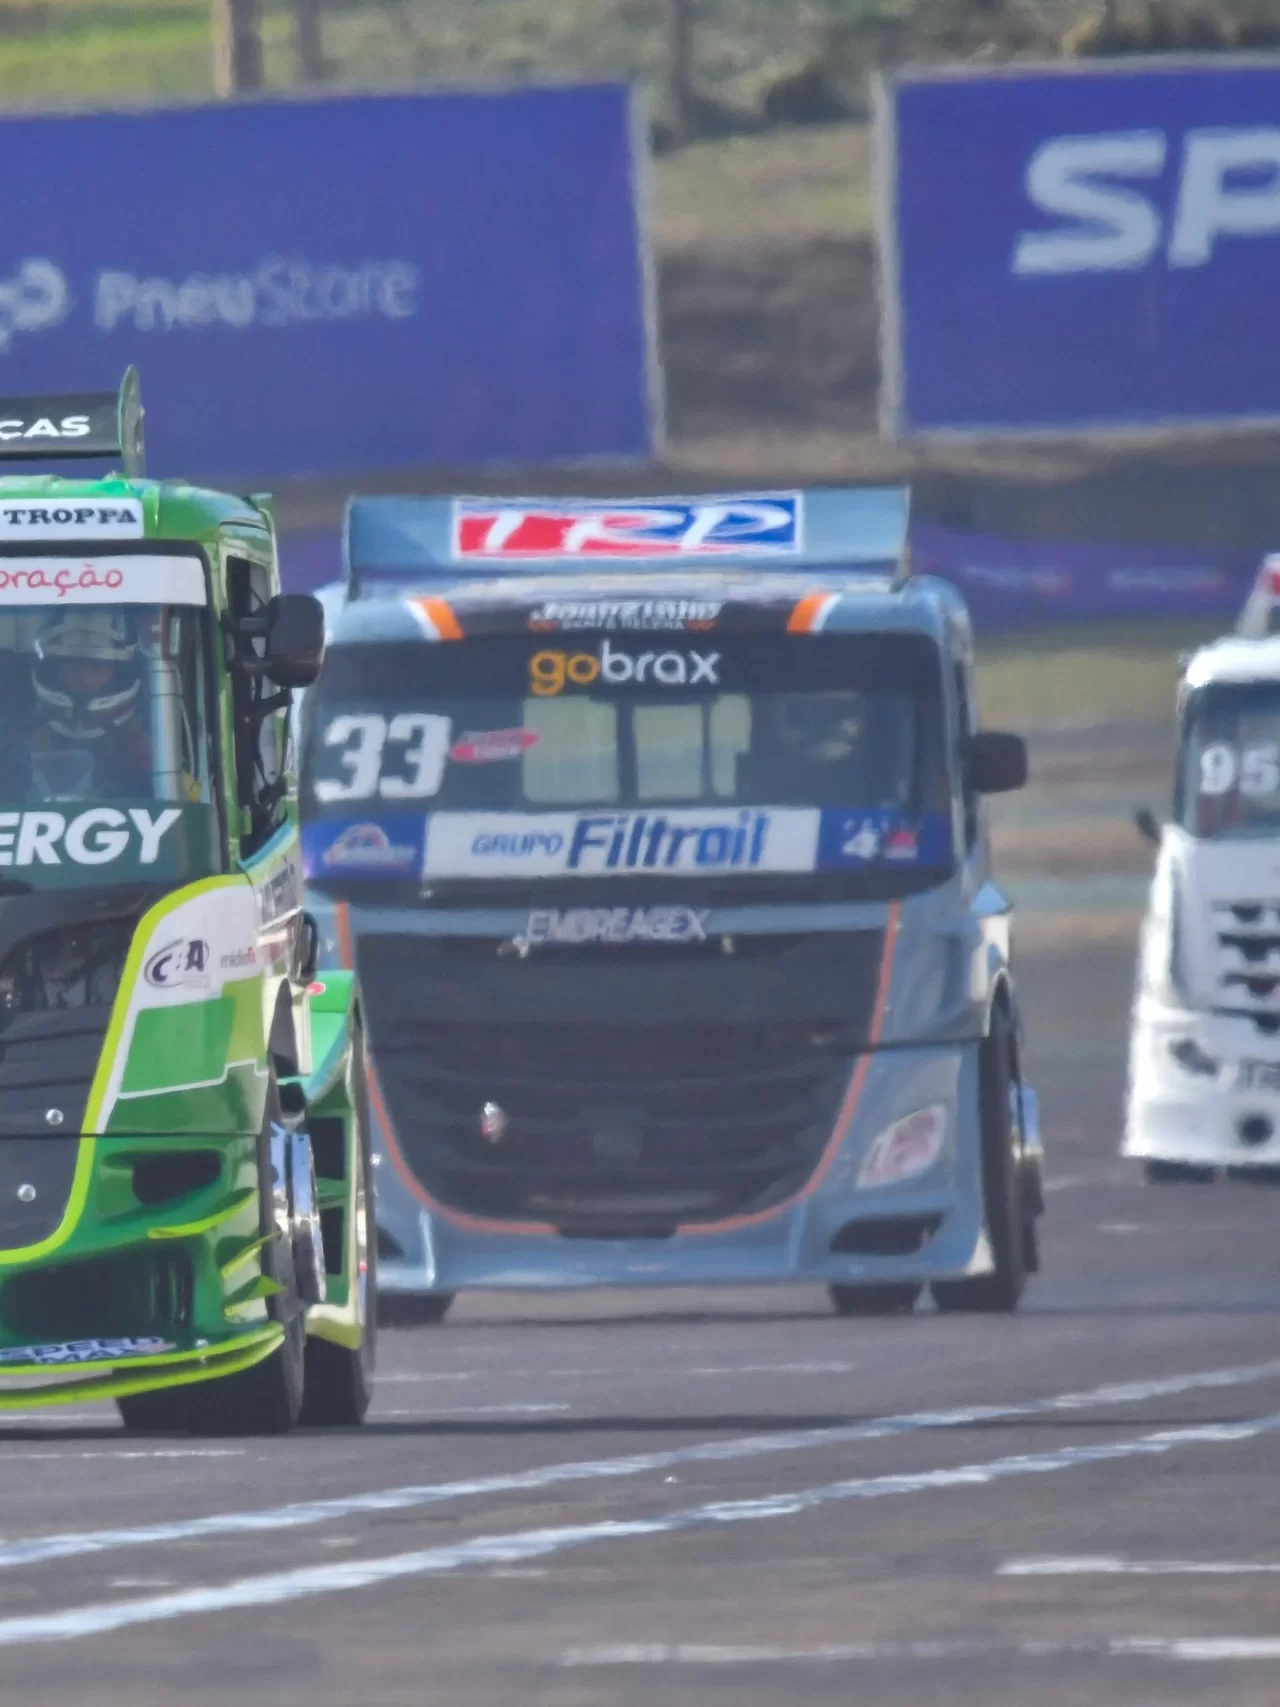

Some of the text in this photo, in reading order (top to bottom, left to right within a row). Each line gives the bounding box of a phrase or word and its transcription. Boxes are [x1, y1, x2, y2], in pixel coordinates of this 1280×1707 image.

[1010, 128, 1280, 273] SP
[95, 255, 418, 332] PneuStore
[3, 507, 138, 524] TROPPA
[458, 504, 794, 554] TRP
[529, 639, 720, 696] gobrax
[314, 713, 452, 803] 33
[1200, 743, 1280, 797] 95
[471, 832, 564, 857] GRUPO
